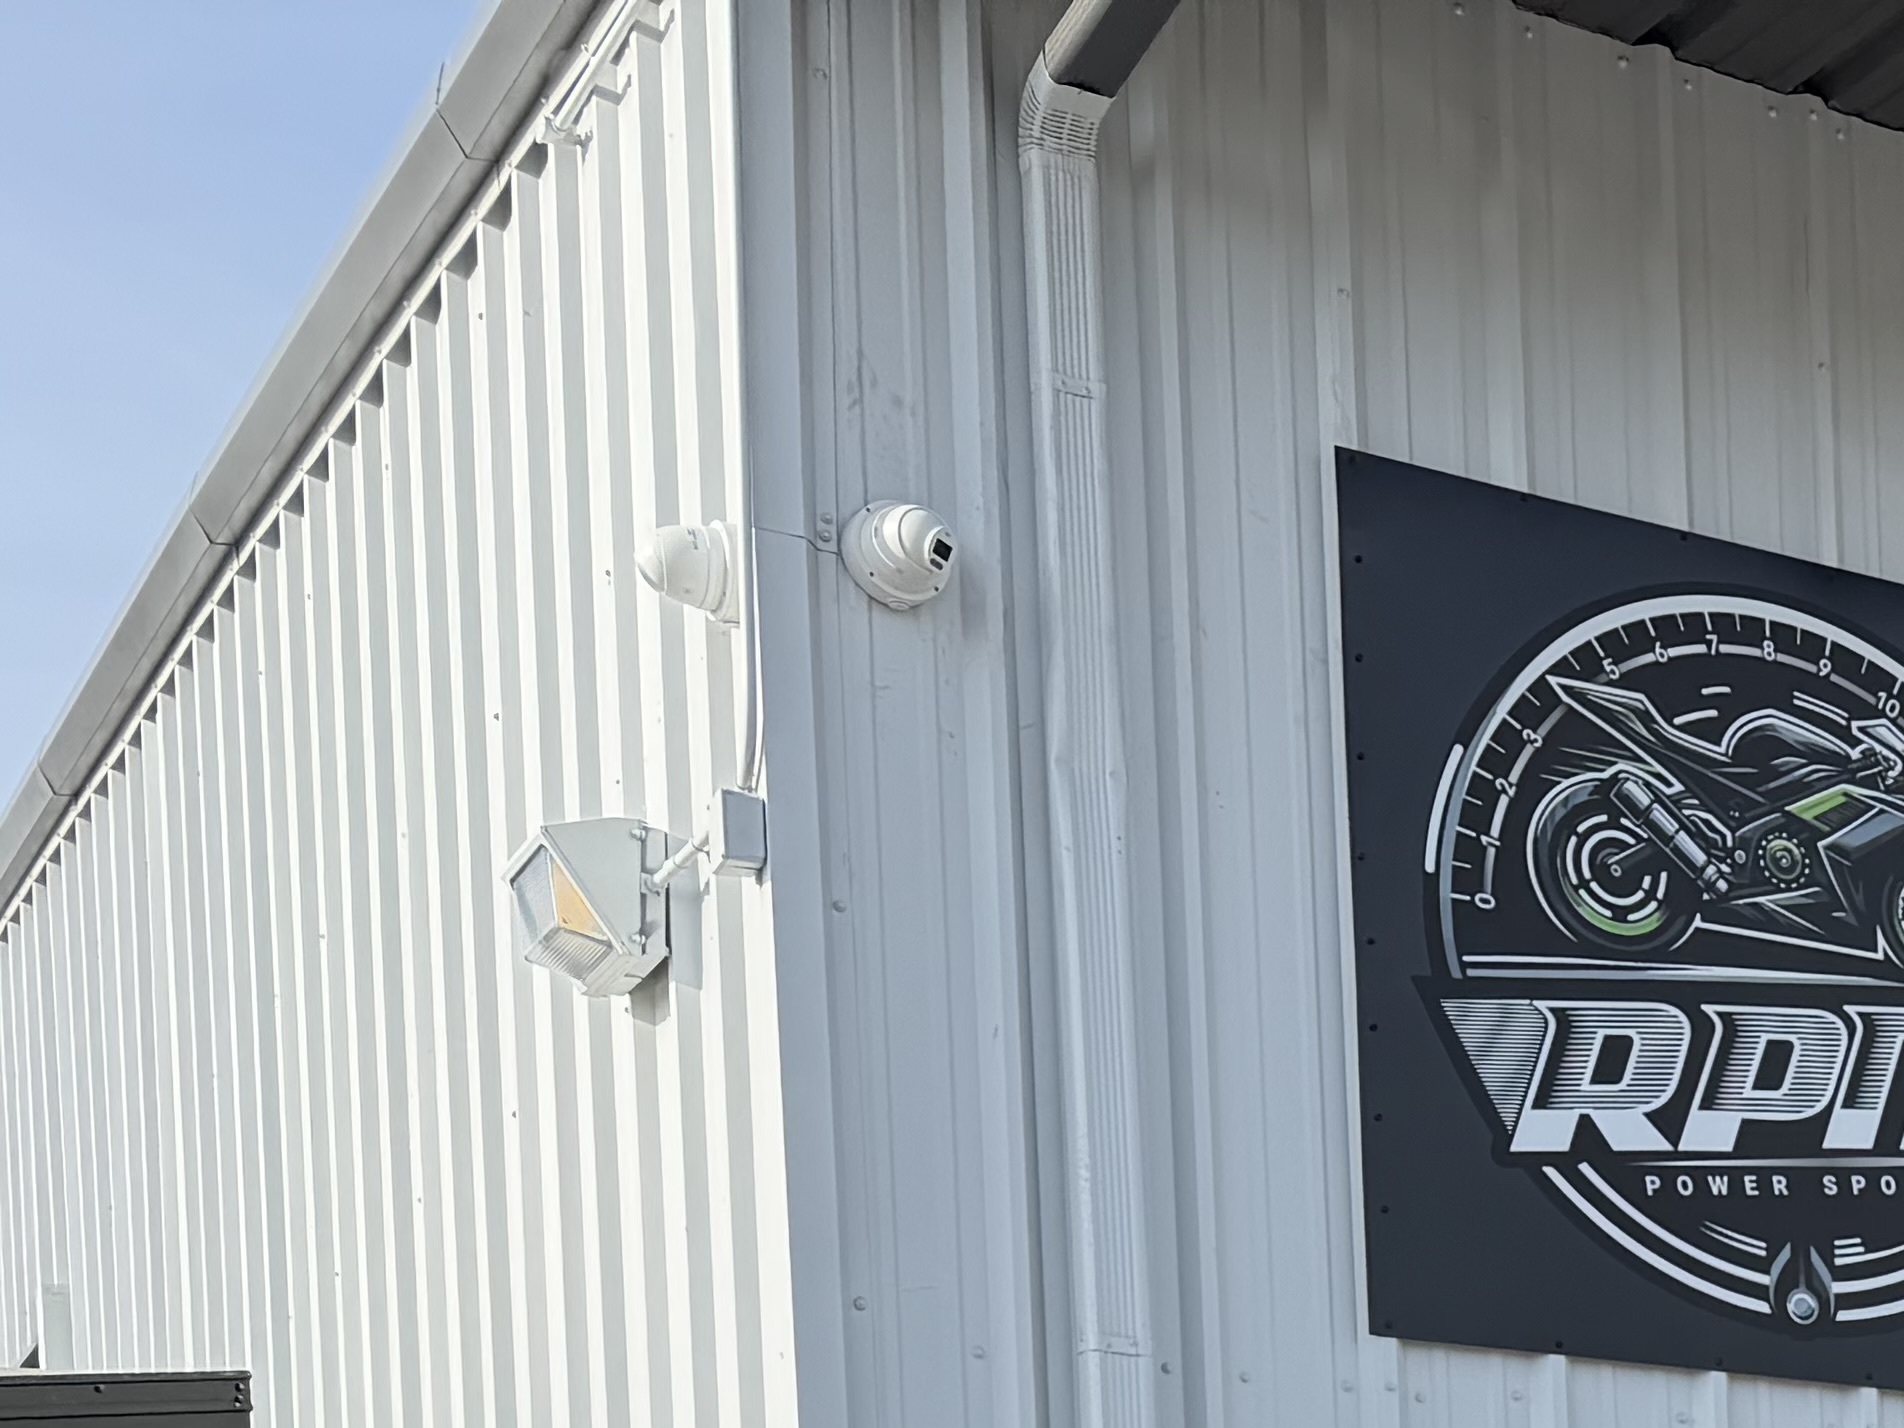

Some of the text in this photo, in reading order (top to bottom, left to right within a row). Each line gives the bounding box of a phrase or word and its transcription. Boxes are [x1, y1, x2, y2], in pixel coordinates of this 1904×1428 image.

[1655, 641, 1669, 662] 6
[1705, 636, 1720, 655] 7
[1762, 640, 1775, 660] 8
[1602, 658, 1620, 680] 5
[1819, 658, 1833, 677] 9
[1876, 692, 1900, 717] 10
[1524, 728, 1544, 749] 3
[1495, 778, 1514, 798] 2
[1481, 832, 1498, 851] 1
[1473, 892, 1495, 911] 0
[1645, 1173, 1791, 1197] POWER
